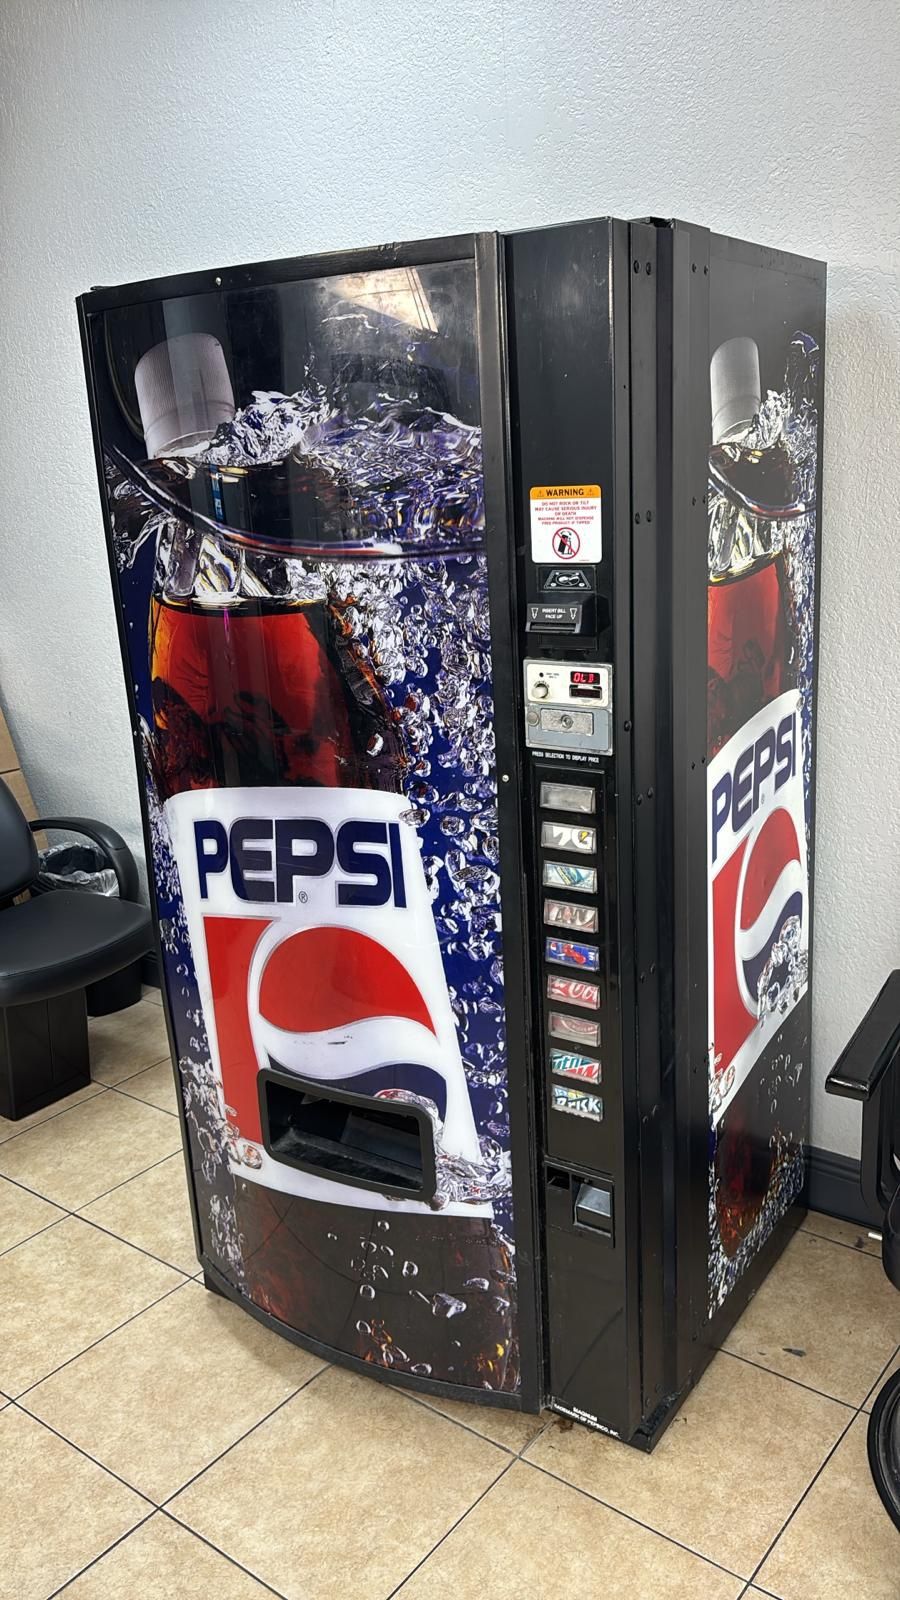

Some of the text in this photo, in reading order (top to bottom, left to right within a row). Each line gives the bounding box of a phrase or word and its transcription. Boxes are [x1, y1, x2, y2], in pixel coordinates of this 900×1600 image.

[546, 488, 584, 497] WARNING
[712, 712, 796, 865] PEPSI
[193, 818, 407, 908] PEPSI
